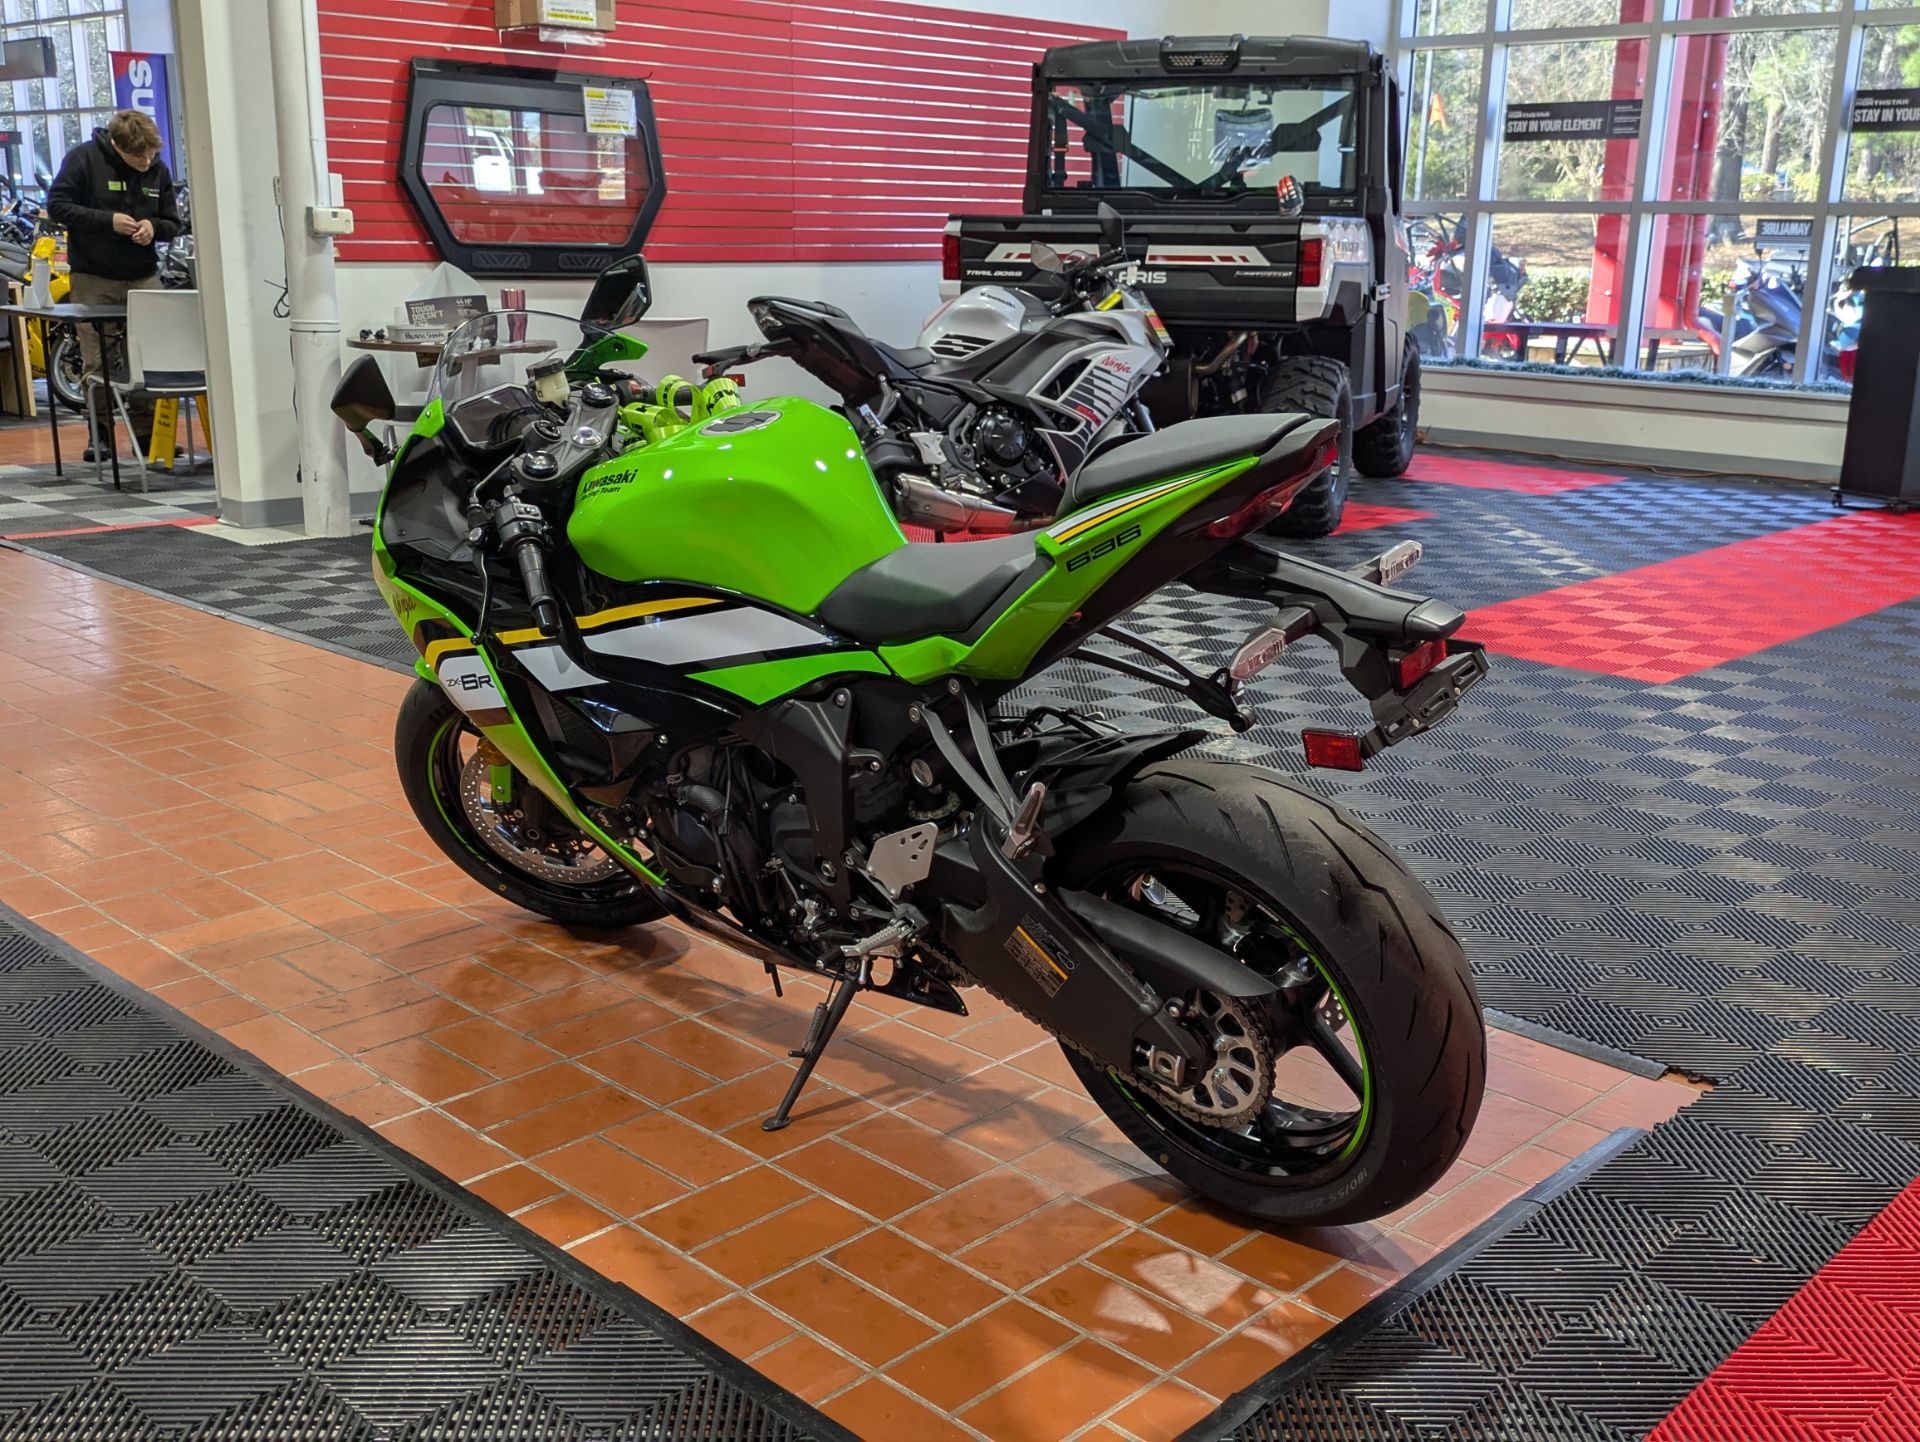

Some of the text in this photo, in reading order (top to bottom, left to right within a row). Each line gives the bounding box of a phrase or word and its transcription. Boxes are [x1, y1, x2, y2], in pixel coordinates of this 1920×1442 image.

[1854, 109, 1880, 122] STAY
[1881, 108, 1894, 122] IN
[1507, 118, 1603, 133] STAY IN YOUR ELEMENT
[410, 303, 436, 315] TOUGH
[411, 309, 444, 321] DOESN'T
[1101, 355, 1132, 373] Ninja
[1065, 524, 1142, 573] 636
[446, 673, 495, 691] ZX-6R
